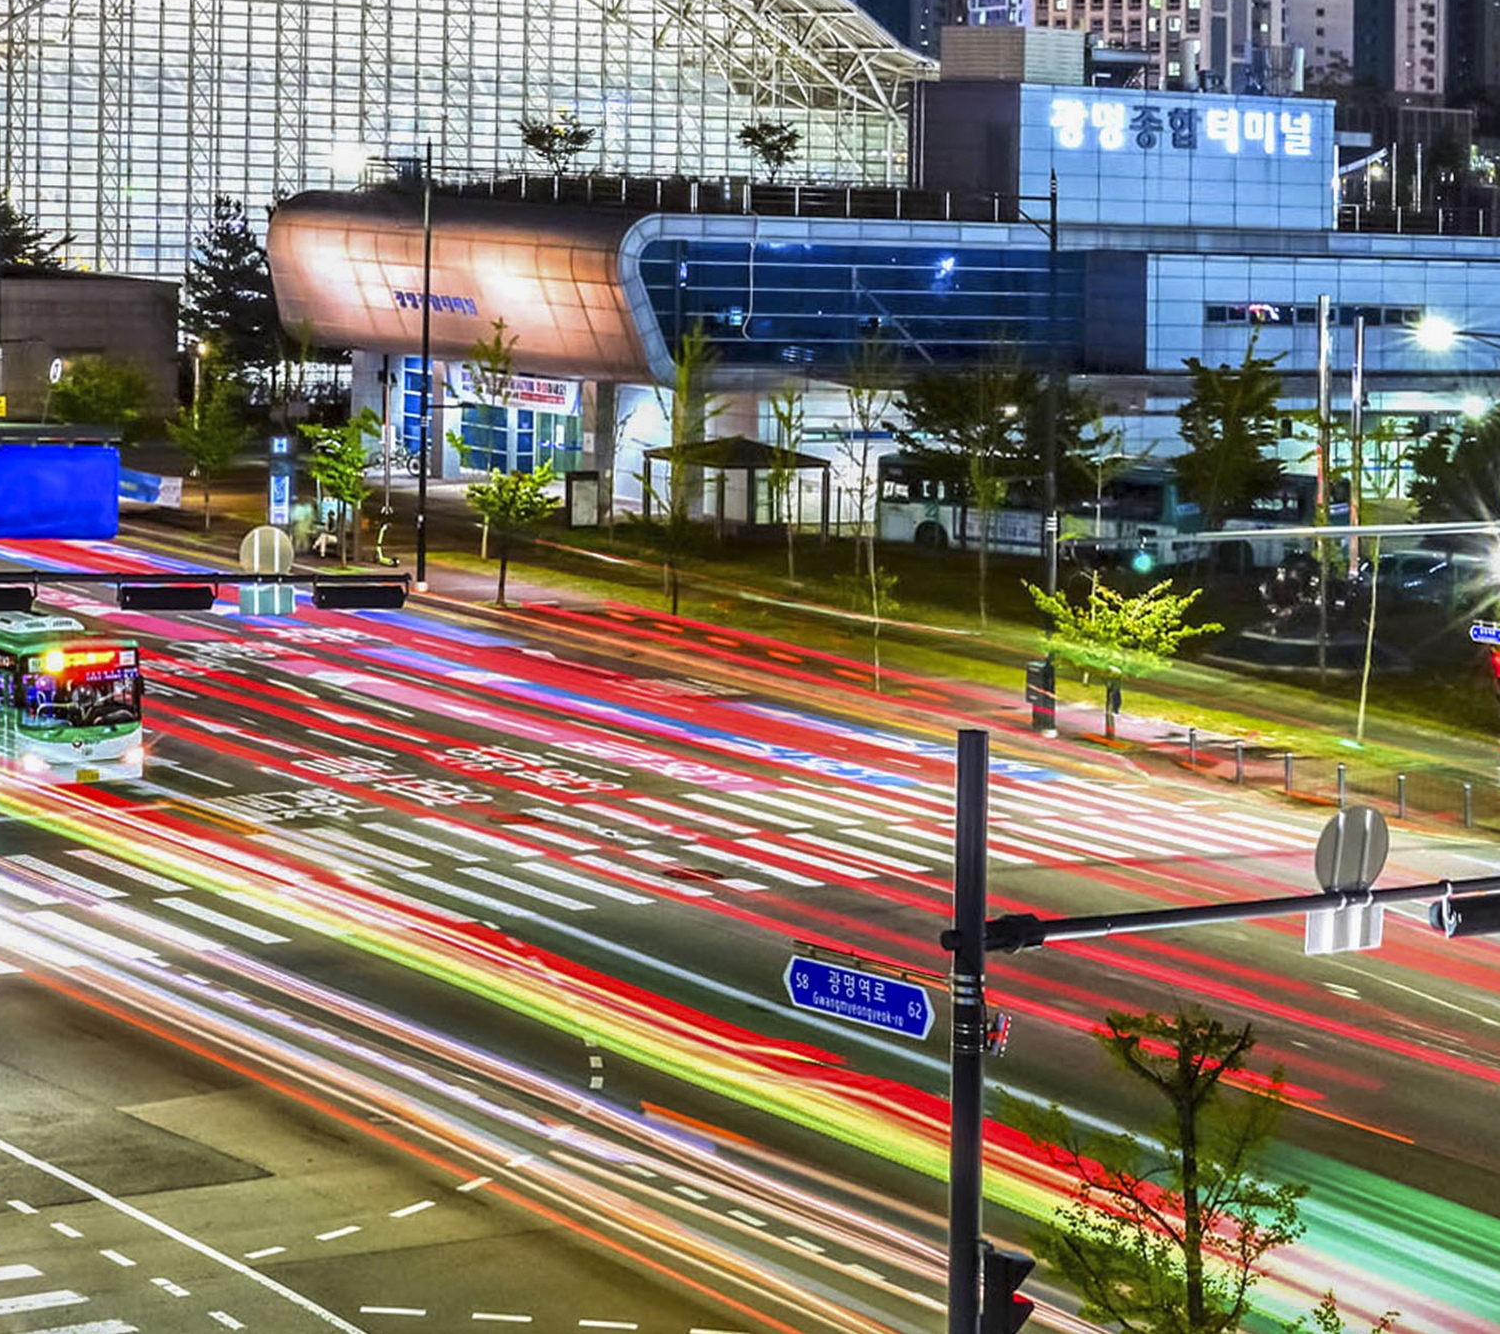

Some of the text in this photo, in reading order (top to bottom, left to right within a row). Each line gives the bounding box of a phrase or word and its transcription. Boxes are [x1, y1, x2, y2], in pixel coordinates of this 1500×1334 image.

[1050, 97, 1312, 156] 광명종합터미널
[794, 970, 923, 1020] 58 광명역로 62
